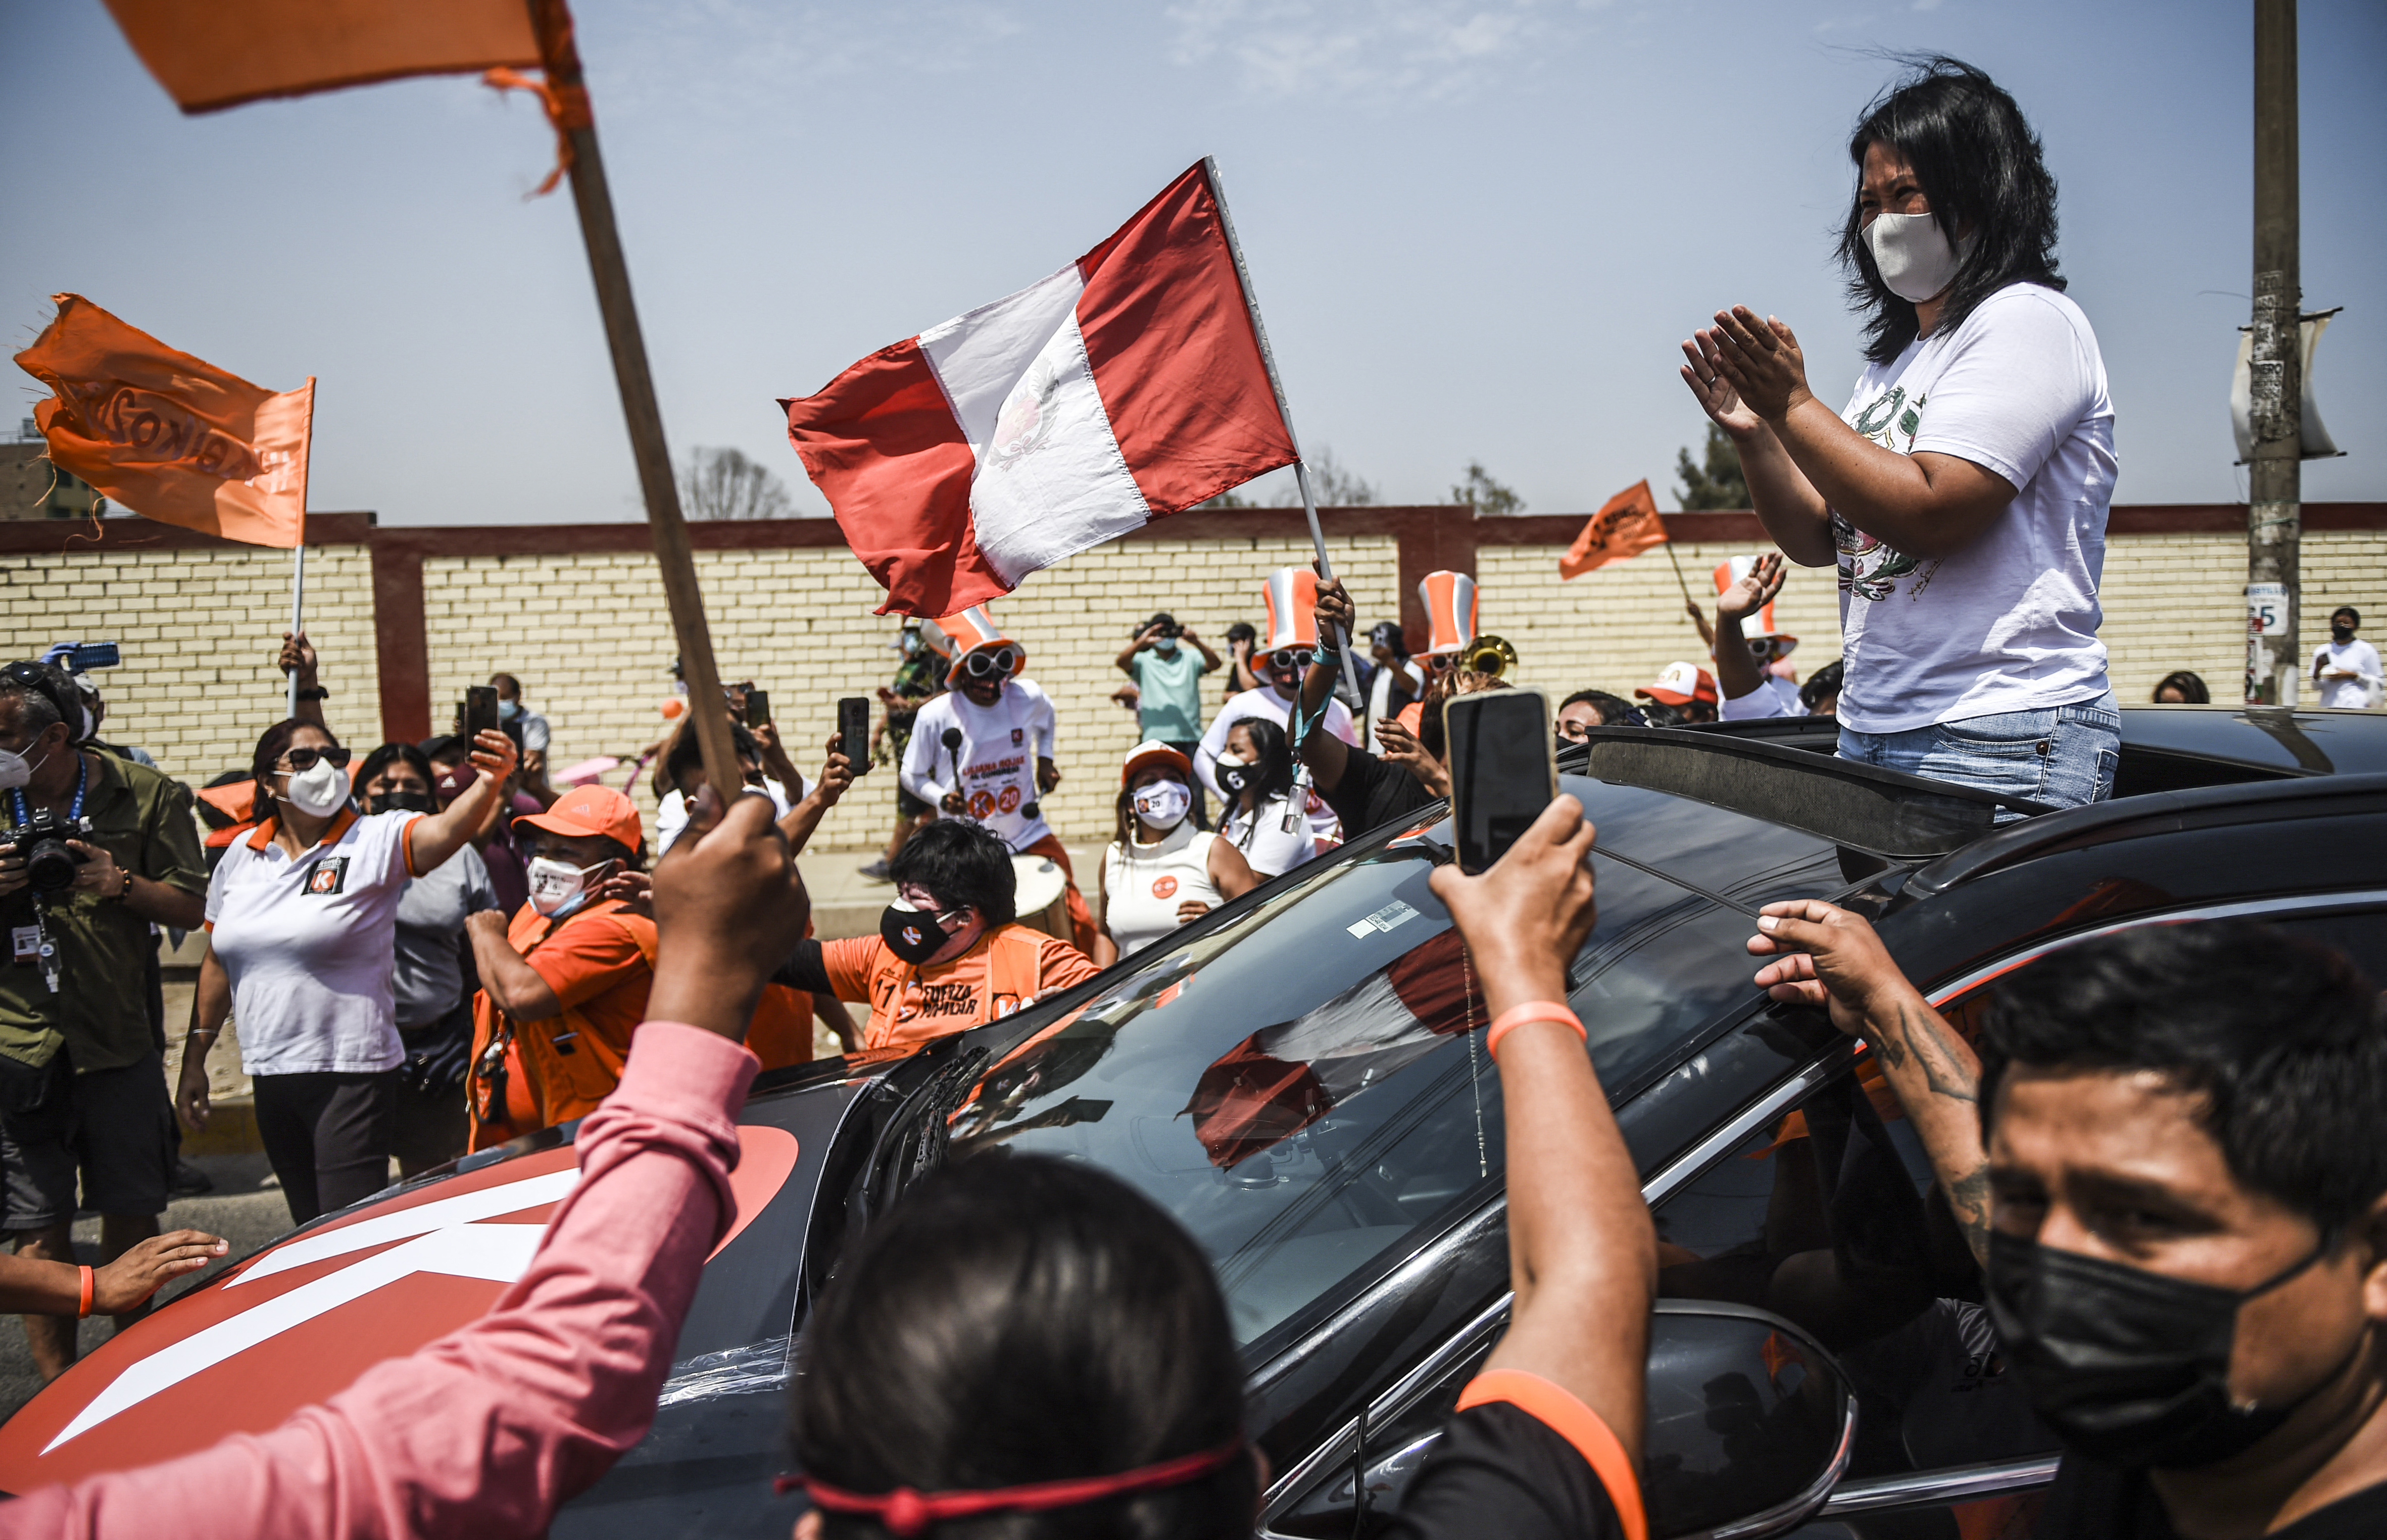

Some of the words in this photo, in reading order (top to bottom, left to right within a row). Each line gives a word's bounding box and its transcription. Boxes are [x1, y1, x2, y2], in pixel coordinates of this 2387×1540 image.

[1001, 790, 1018, 809] 20
[1151, 800, 1160, 808] 20
[314, 871, 332, 889] K
[902, 926, 921, 945] K
